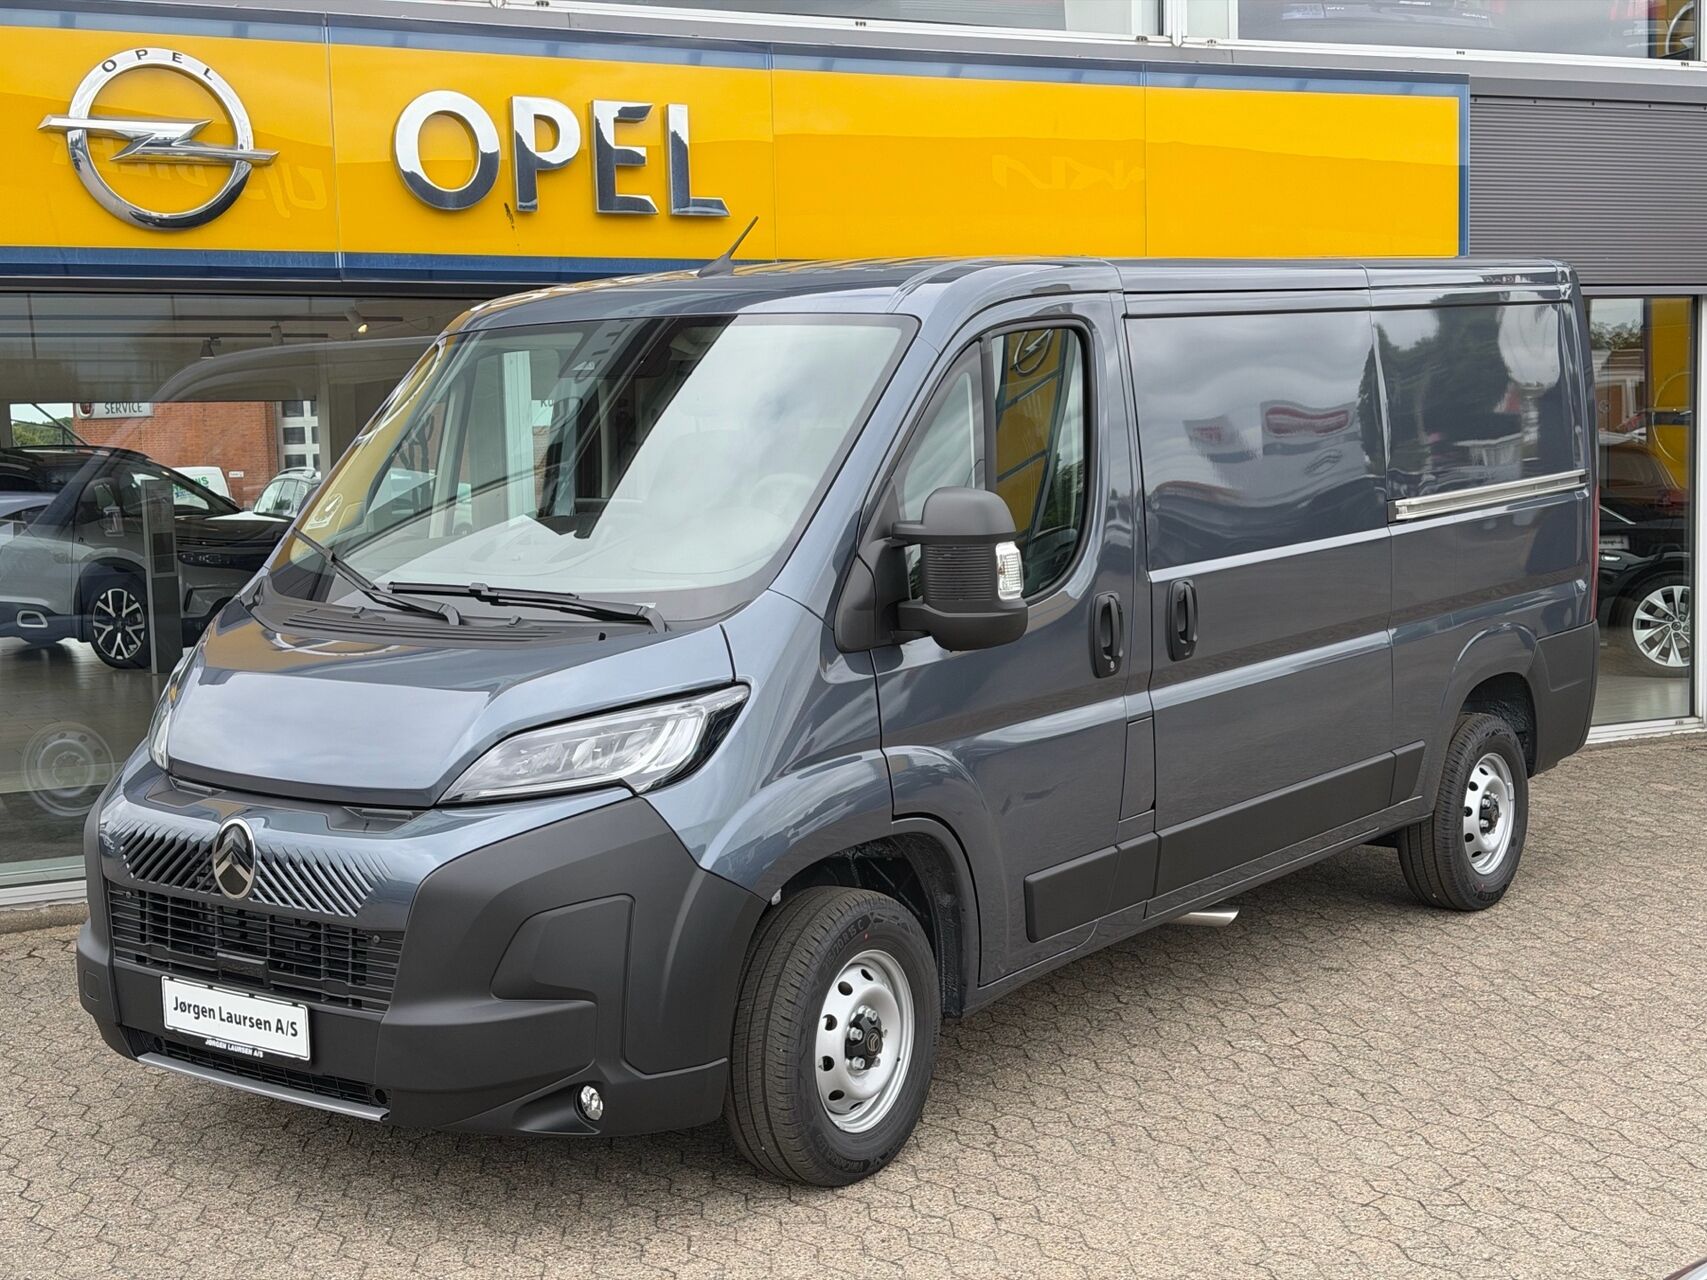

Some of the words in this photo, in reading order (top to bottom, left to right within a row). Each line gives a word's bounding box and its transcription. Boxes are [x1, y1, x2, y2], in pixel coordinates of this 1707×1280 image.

[101, 48, 213, 81] OPEL
[393, 90, 730, 217] OPEL
[104, 402, 143, 414] SERVICE
[173, 996, 216, 1020] Jørgen
[218, 1006, 272, 1032] Laursen
[275, 1018, 298, 1037] A/S
